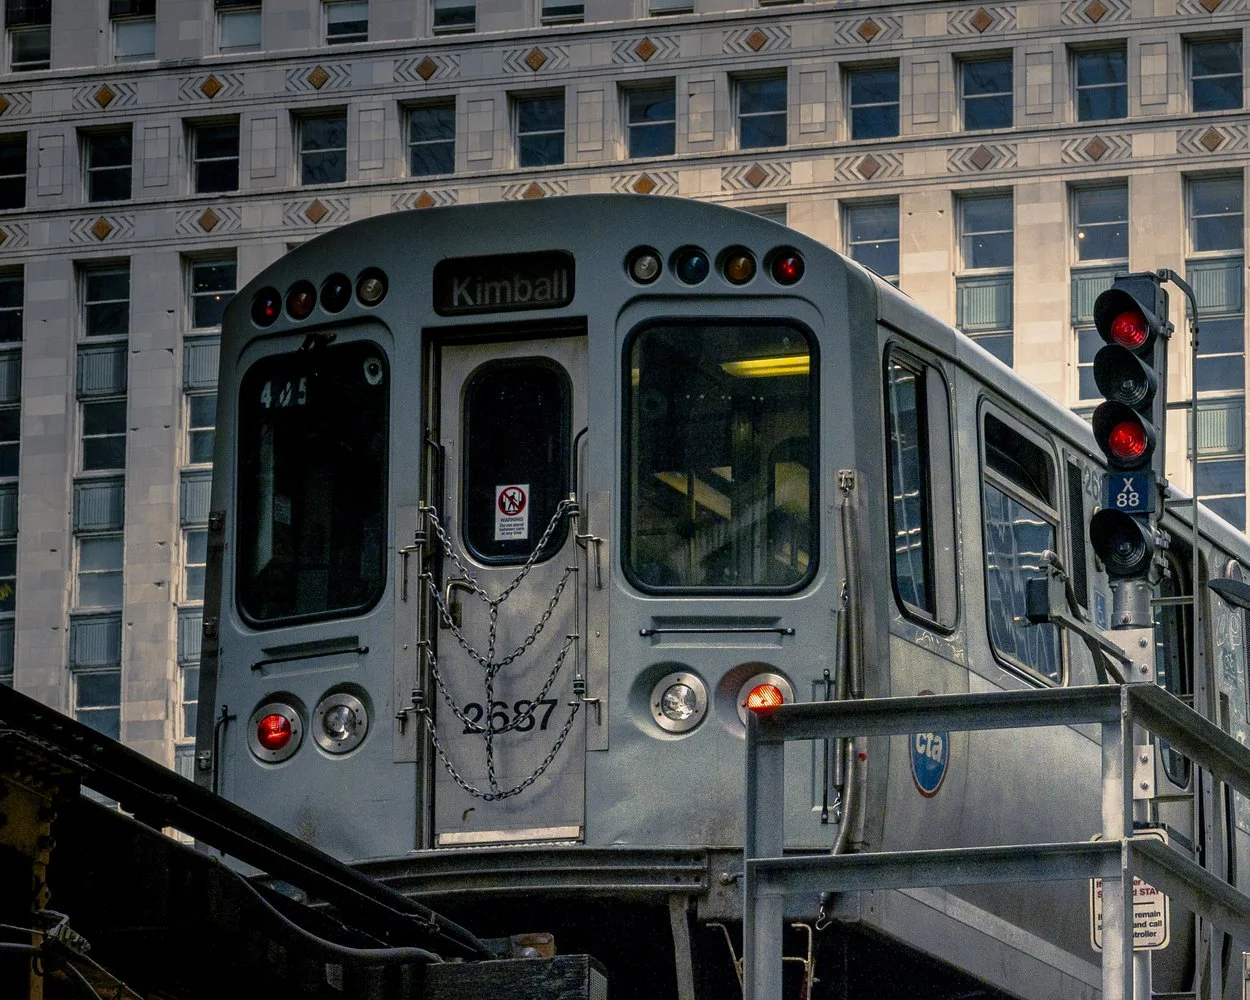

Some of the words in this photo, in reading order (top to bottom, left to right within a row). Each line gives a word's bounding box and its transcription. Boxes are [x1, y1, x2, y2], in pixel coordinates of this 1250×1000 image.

[452, 268, 568, 307] Kimball
[1122, 477, 1134, 492] X
[1116, 492, 1140, 508] 88
[463, 698, 558, 734] 2687
[1149, 920, 1162, 928] call
